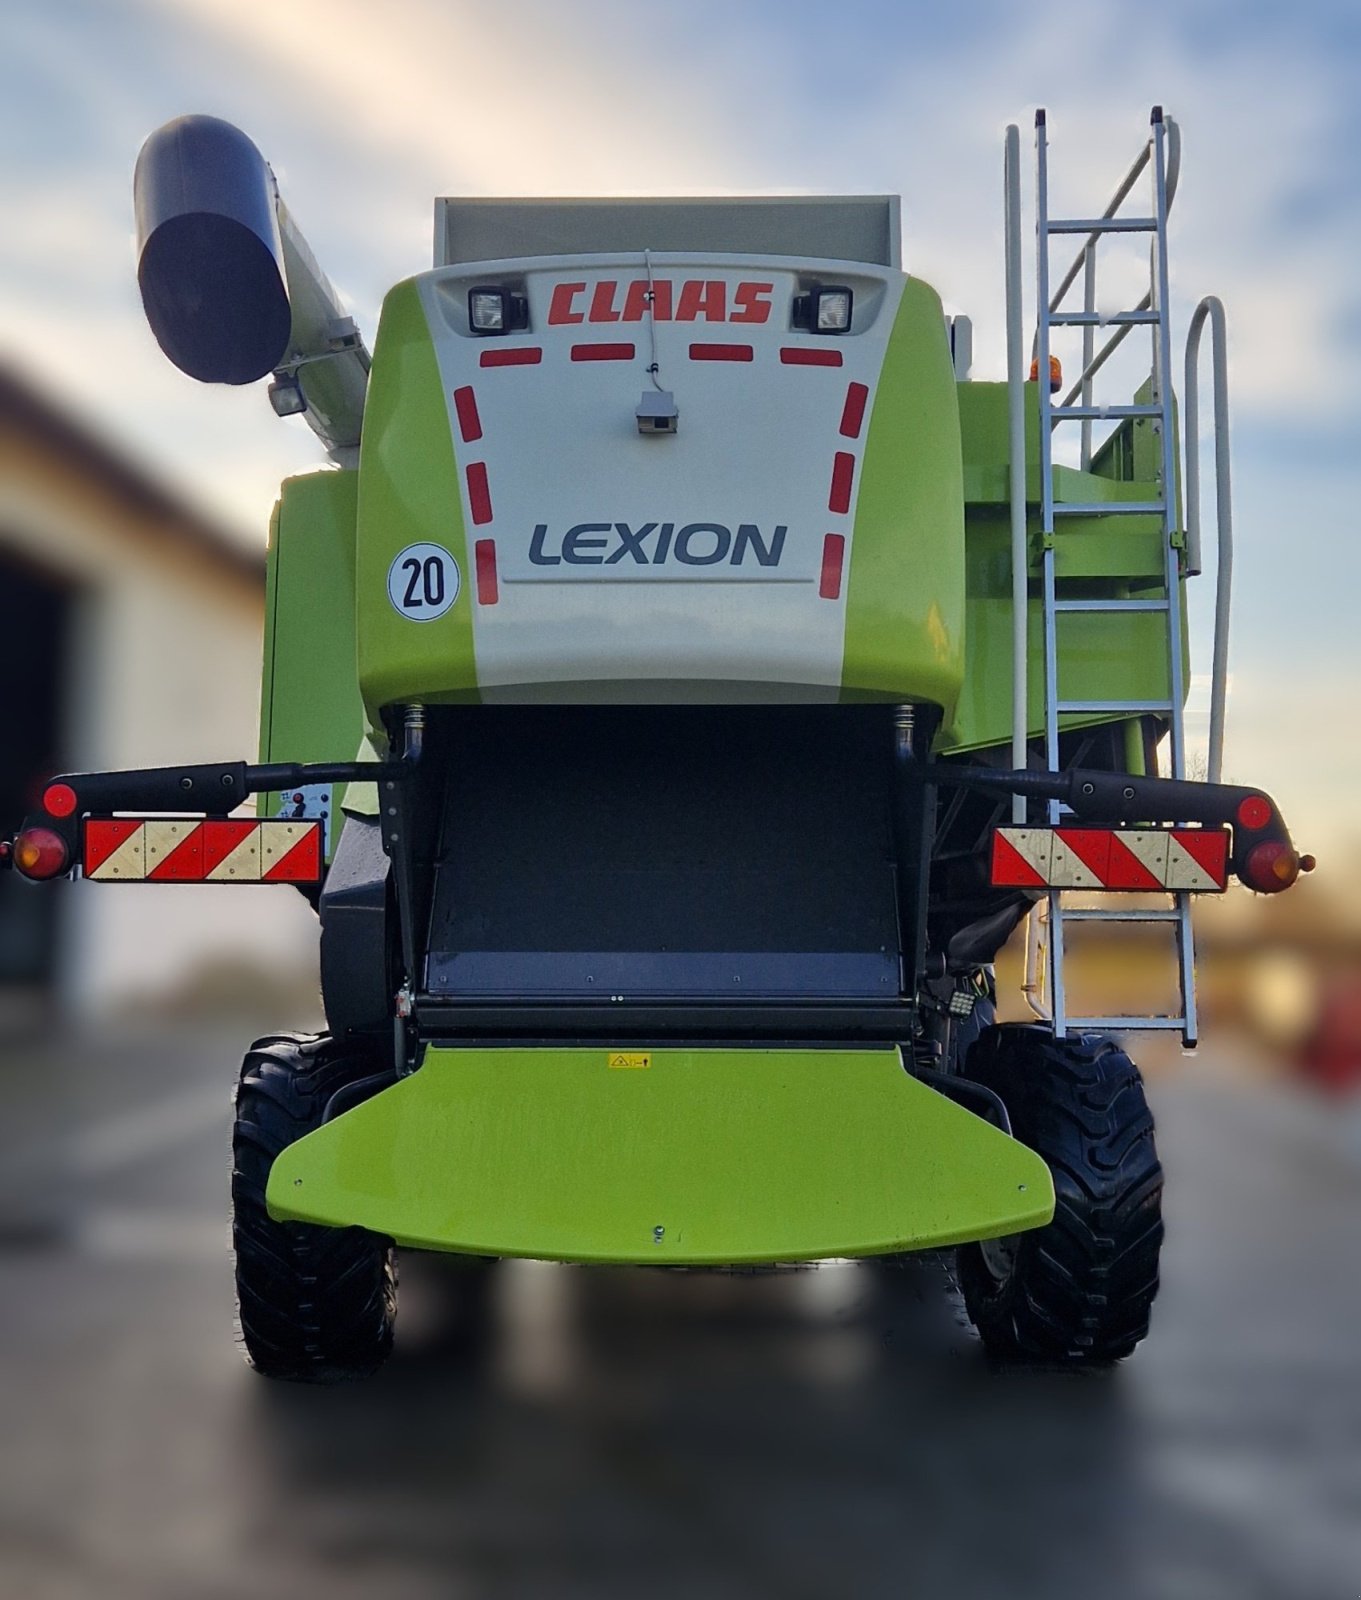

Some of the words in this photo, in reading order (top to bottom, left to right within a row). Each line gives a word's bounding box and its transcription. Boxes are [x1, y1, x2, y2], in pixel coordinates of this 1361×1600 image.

[548, 280, 774, 325] CLAAS
[528, 523, 788, 566] LEXION
[402, 556, 444, 607] 20
